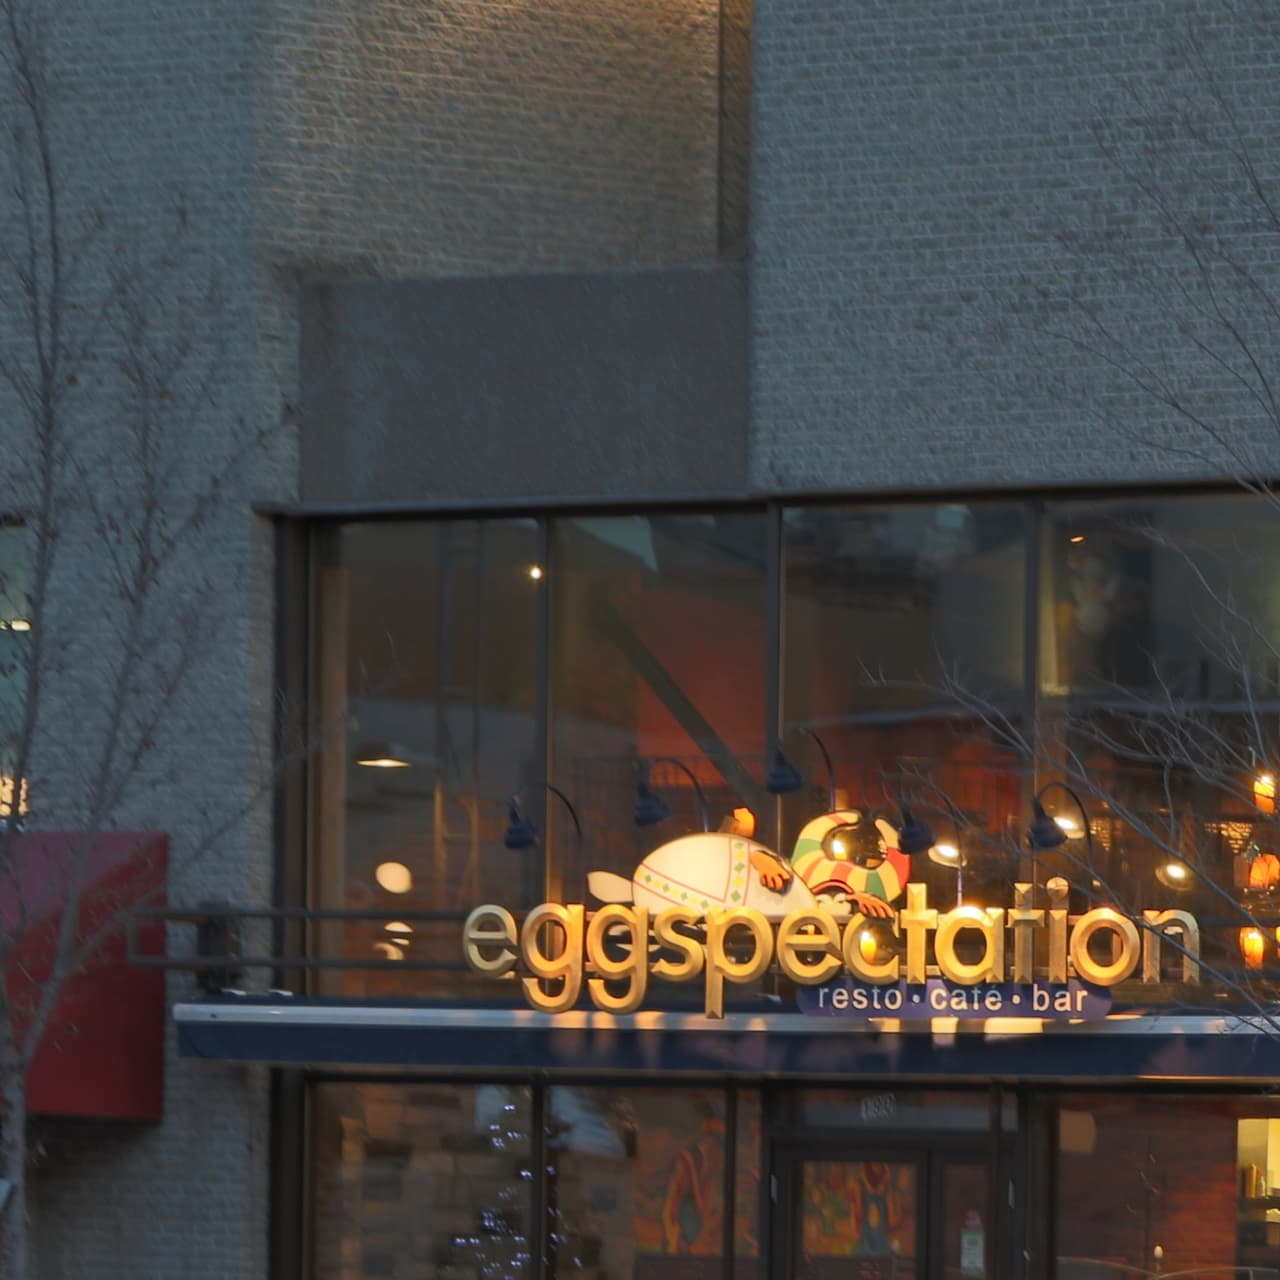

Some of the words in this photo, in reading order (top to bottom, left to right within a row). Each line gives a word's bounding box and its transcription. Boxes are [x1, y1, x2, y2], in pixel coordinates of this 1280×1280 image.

[463, 877, 1200, 1019] eggspectation
[819, 985, 902, 1010] resto
[1032, 984, 1088, 1011] bar
